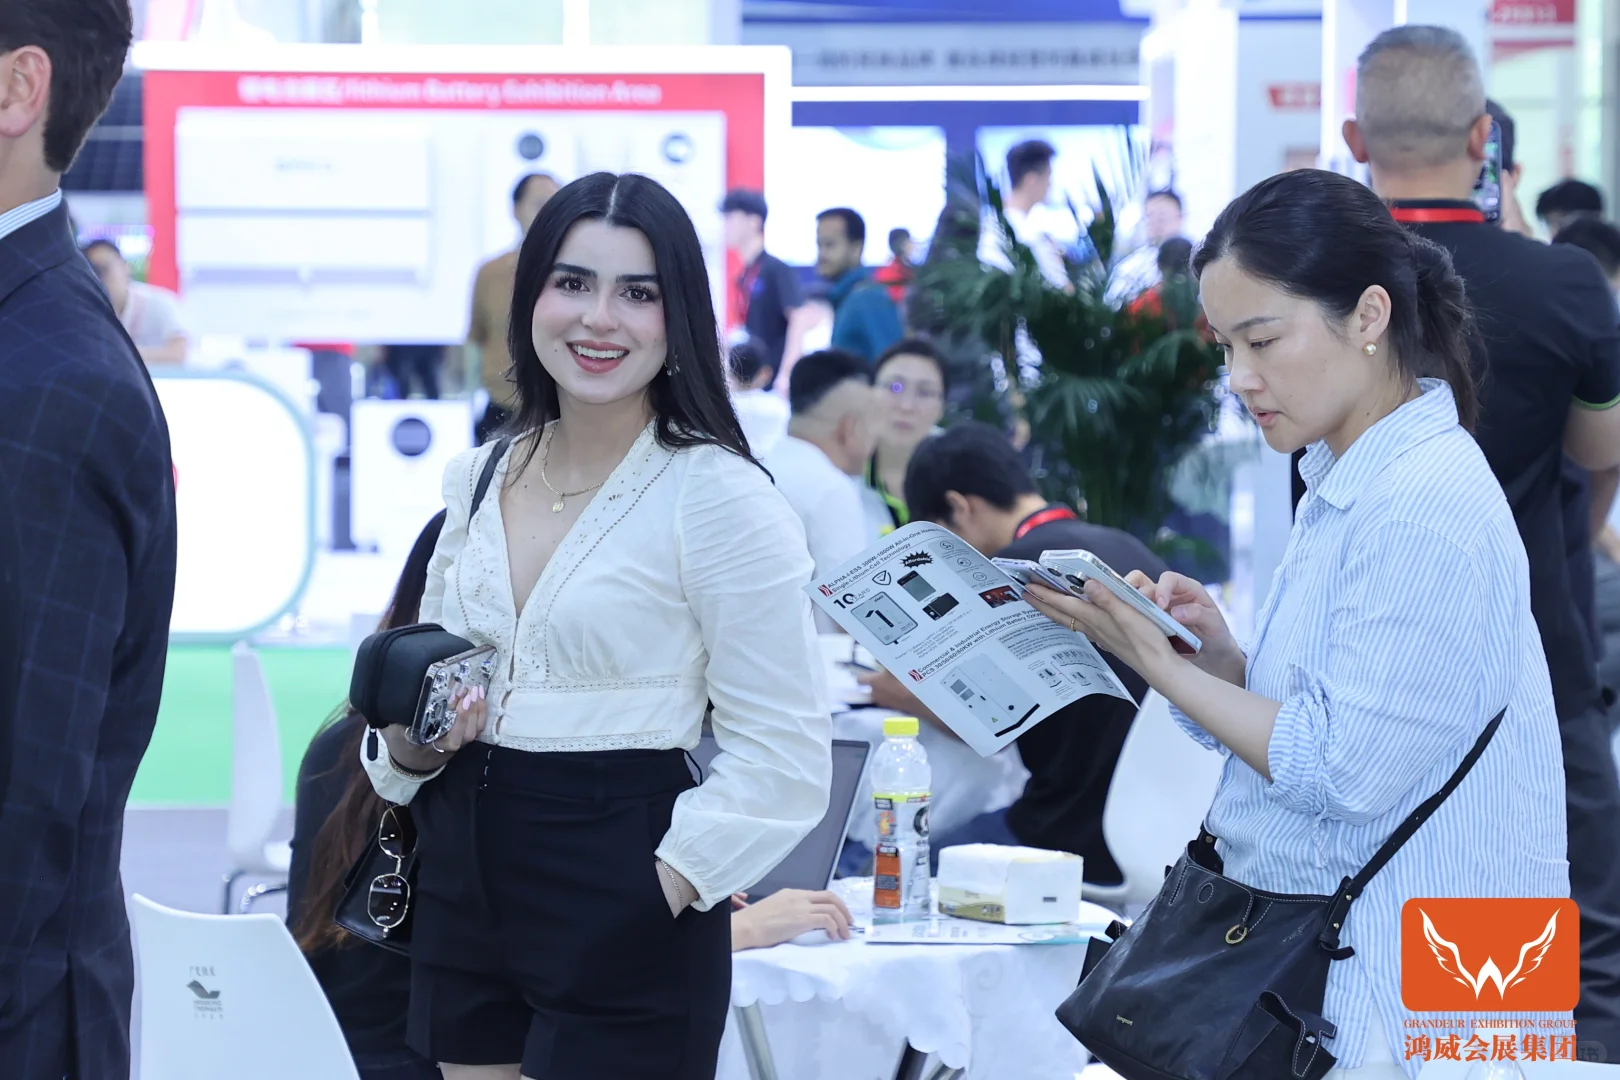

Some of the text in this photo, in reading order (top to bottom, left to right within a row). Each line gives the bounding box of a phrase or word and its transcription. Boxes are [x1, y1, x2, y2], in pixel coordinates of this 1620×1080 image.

[880, 543, 911, 562] Technology
[905, 556, 931, 565] Affordable
[918, 650, 949, 673] Commercial
[949, 646, 956, 654] &
[955, 630, 981, 648] Industrial
[980, 619, 1001, 633] Energy
[923, 668, 935, 677] PCS
[973, 633, 985, 644] with
[985, 623, 1006, 636] Lithium
[1007, 616, 1027, 626] Battery
